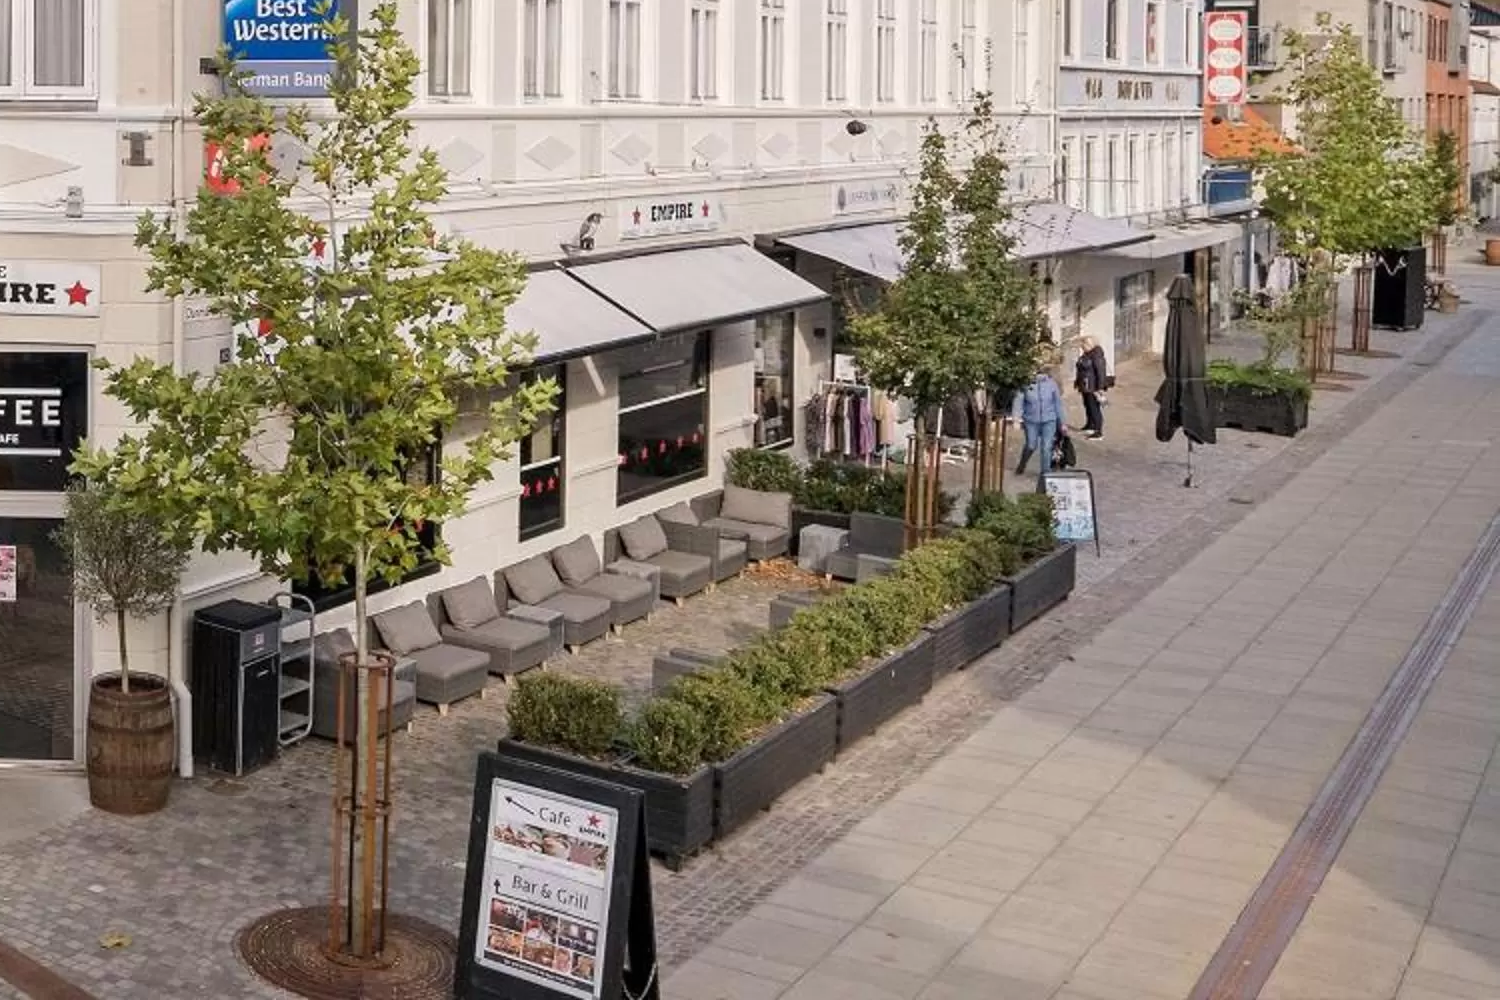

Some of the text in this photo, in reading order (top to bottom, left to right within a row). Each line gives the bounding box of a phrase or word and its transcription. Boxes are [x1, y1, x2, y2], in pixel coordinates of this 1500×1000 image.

[235, 70, 289, 87] erman
[650, 202, 693, 222] EMPIRE
[539, 806, 572, 827] Cafe
[511, 874, 589, 911] Bar & Grill
